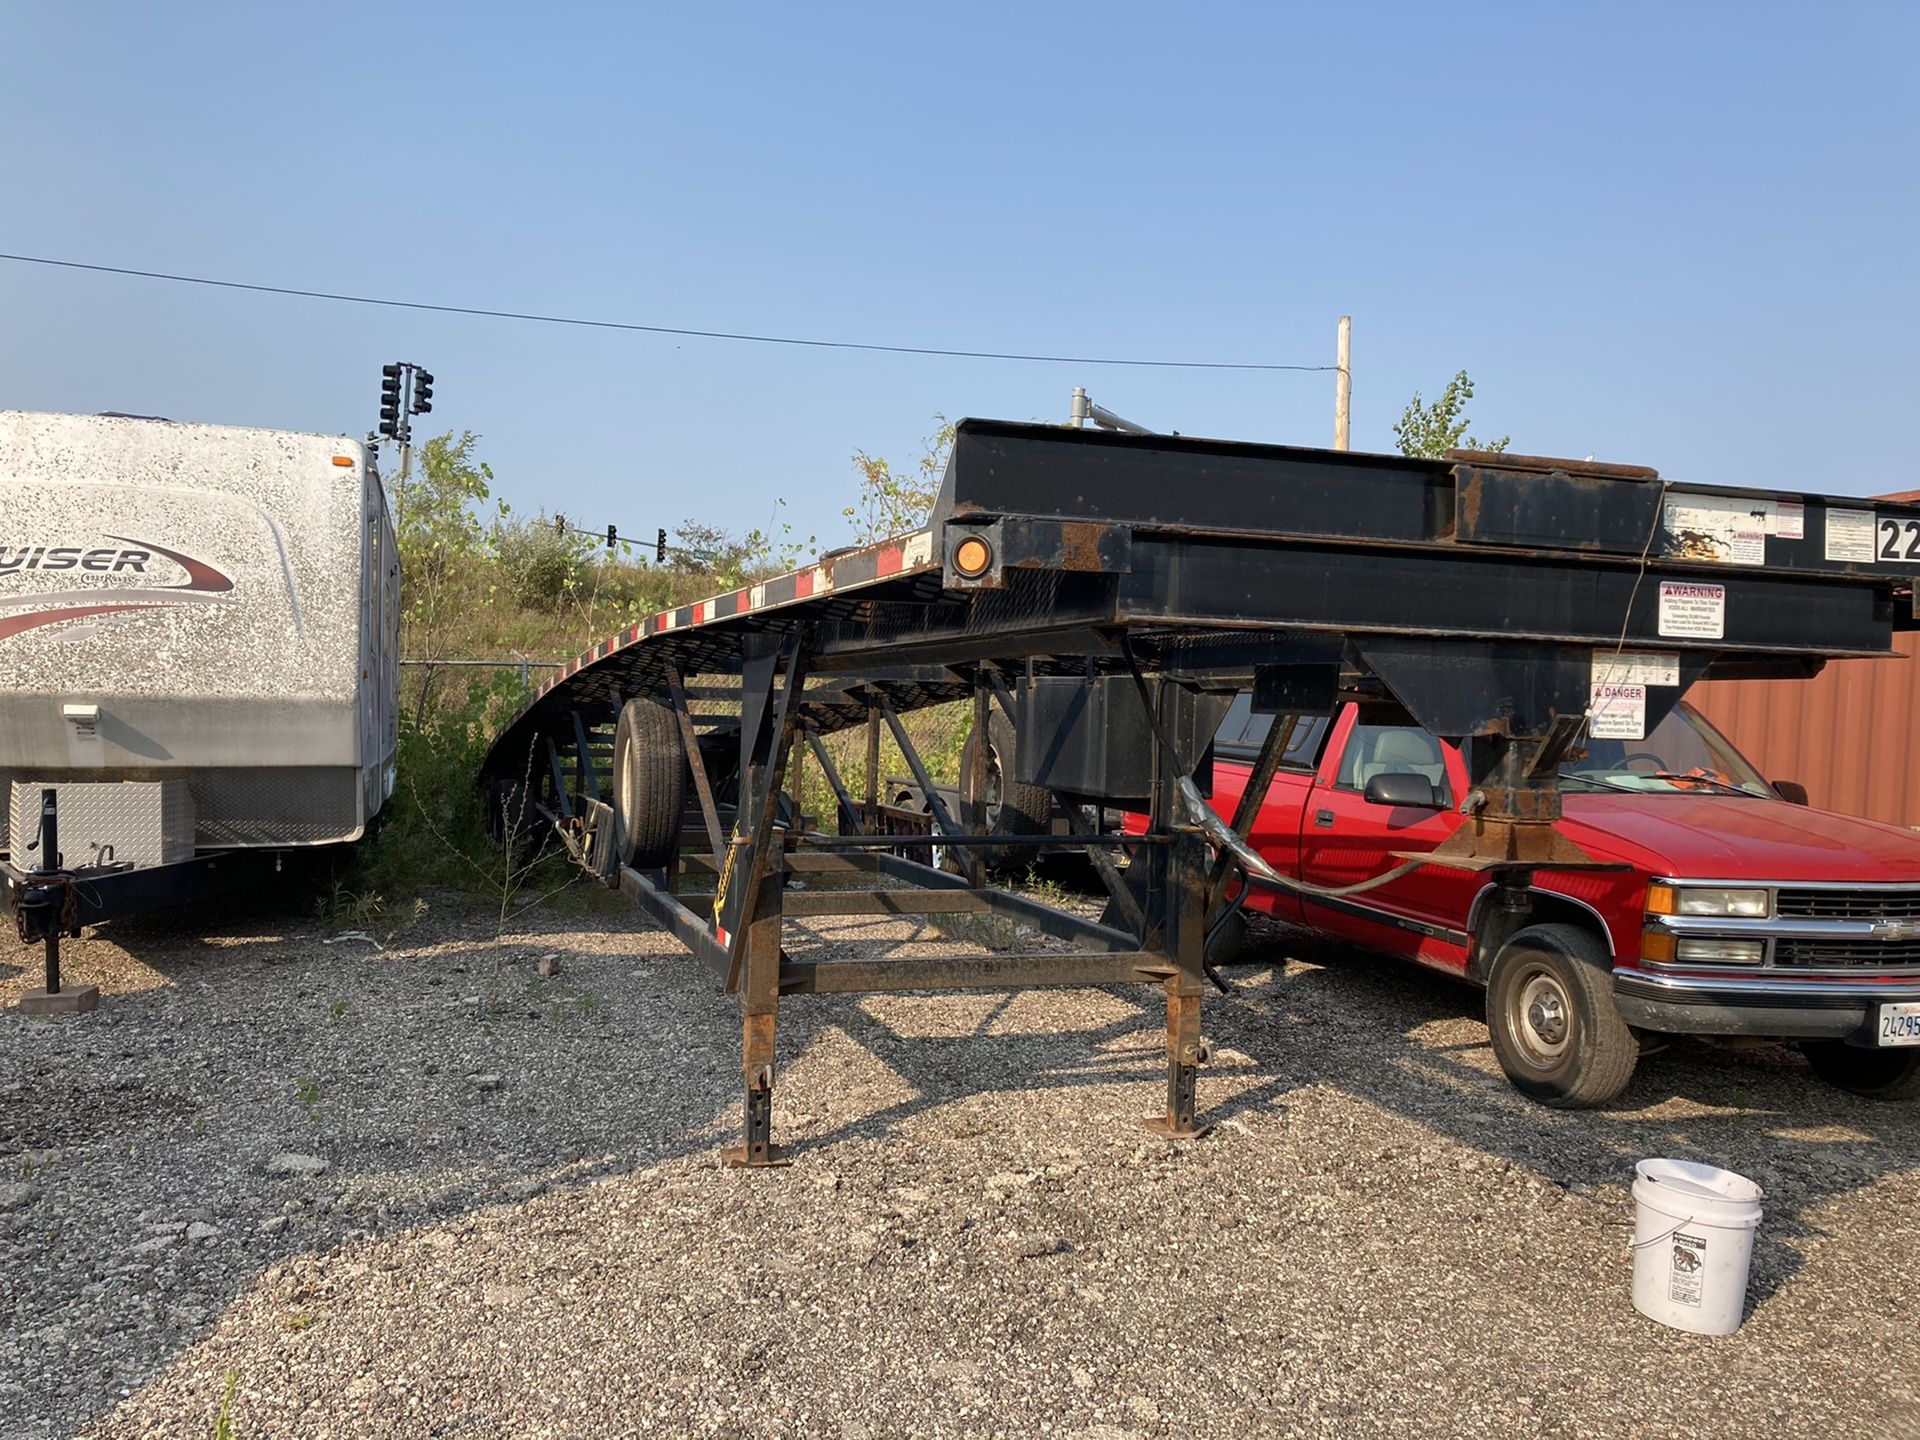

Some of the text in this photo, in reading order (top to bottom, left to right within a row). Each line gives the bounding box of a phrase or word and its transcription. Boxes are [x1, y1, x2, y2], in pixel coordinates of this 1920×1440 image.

[1880, 519, 1920, 559] 22
[1672, 585, 1722, 598] WARNING
[1605, 687, 1642, 698] DANGER
